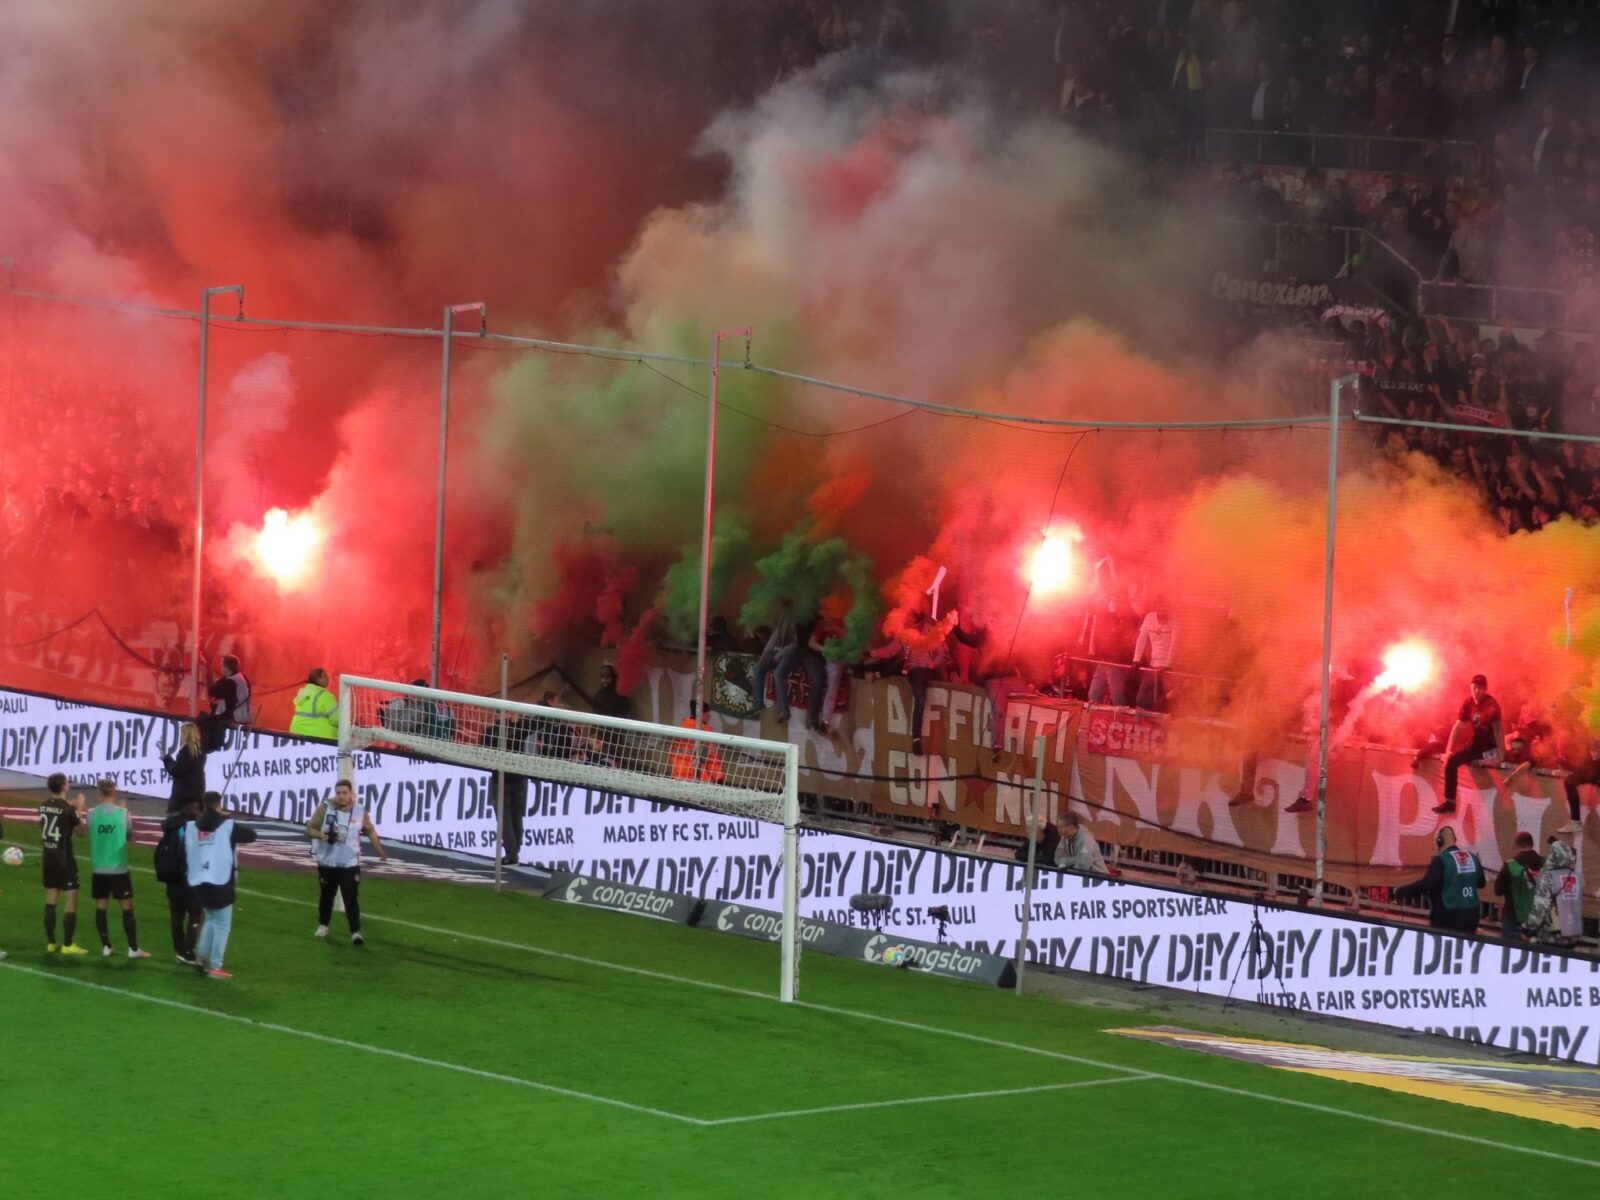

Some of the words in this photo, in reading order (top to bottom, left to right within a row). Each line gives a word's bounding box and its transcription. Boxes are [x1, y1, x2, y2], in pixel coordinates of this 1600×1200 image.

[124, 770, 137, 786] FC
[141, 769, 156, 785] ST.
[264, 759, 292, 777] FAIR
[296, 752, 382, 775] SPORTEAR
[888, 750, 957, 812] CON
[457, 776, 493, 820] Di!
[1068, 748, 1307, 858] NKT
[40, 813, 62, 842] 24
[448, 830, 478, 849] FAIR
[481, 827, 574, 847] SPSWEAR
[603, 824, 645, 843] MADE
[650, 824, 667, 842] BY
[672, 823, 688, 841] FC
[693, 822, 713, 841] ST.
[718, 821, 759, 840] PAULI
[592, 884, 675, 914] congstar
[1014, 901, 1066, 923] ULTRA
[1070, 899, 1107, 920] FAIR
[1112, 896, 1228, 919] SPORTSWEAR
[743, 911, 825, 943] congtar
[906, 907, 927, 926] ST.
[1317, 990, 1356, 1011] FAIR
[1361, 988, 1488, 1010] SPORTSWEAR
[1526, 986, 1583, 1008] MADE
[1589, 986, 1600, 1007] B
